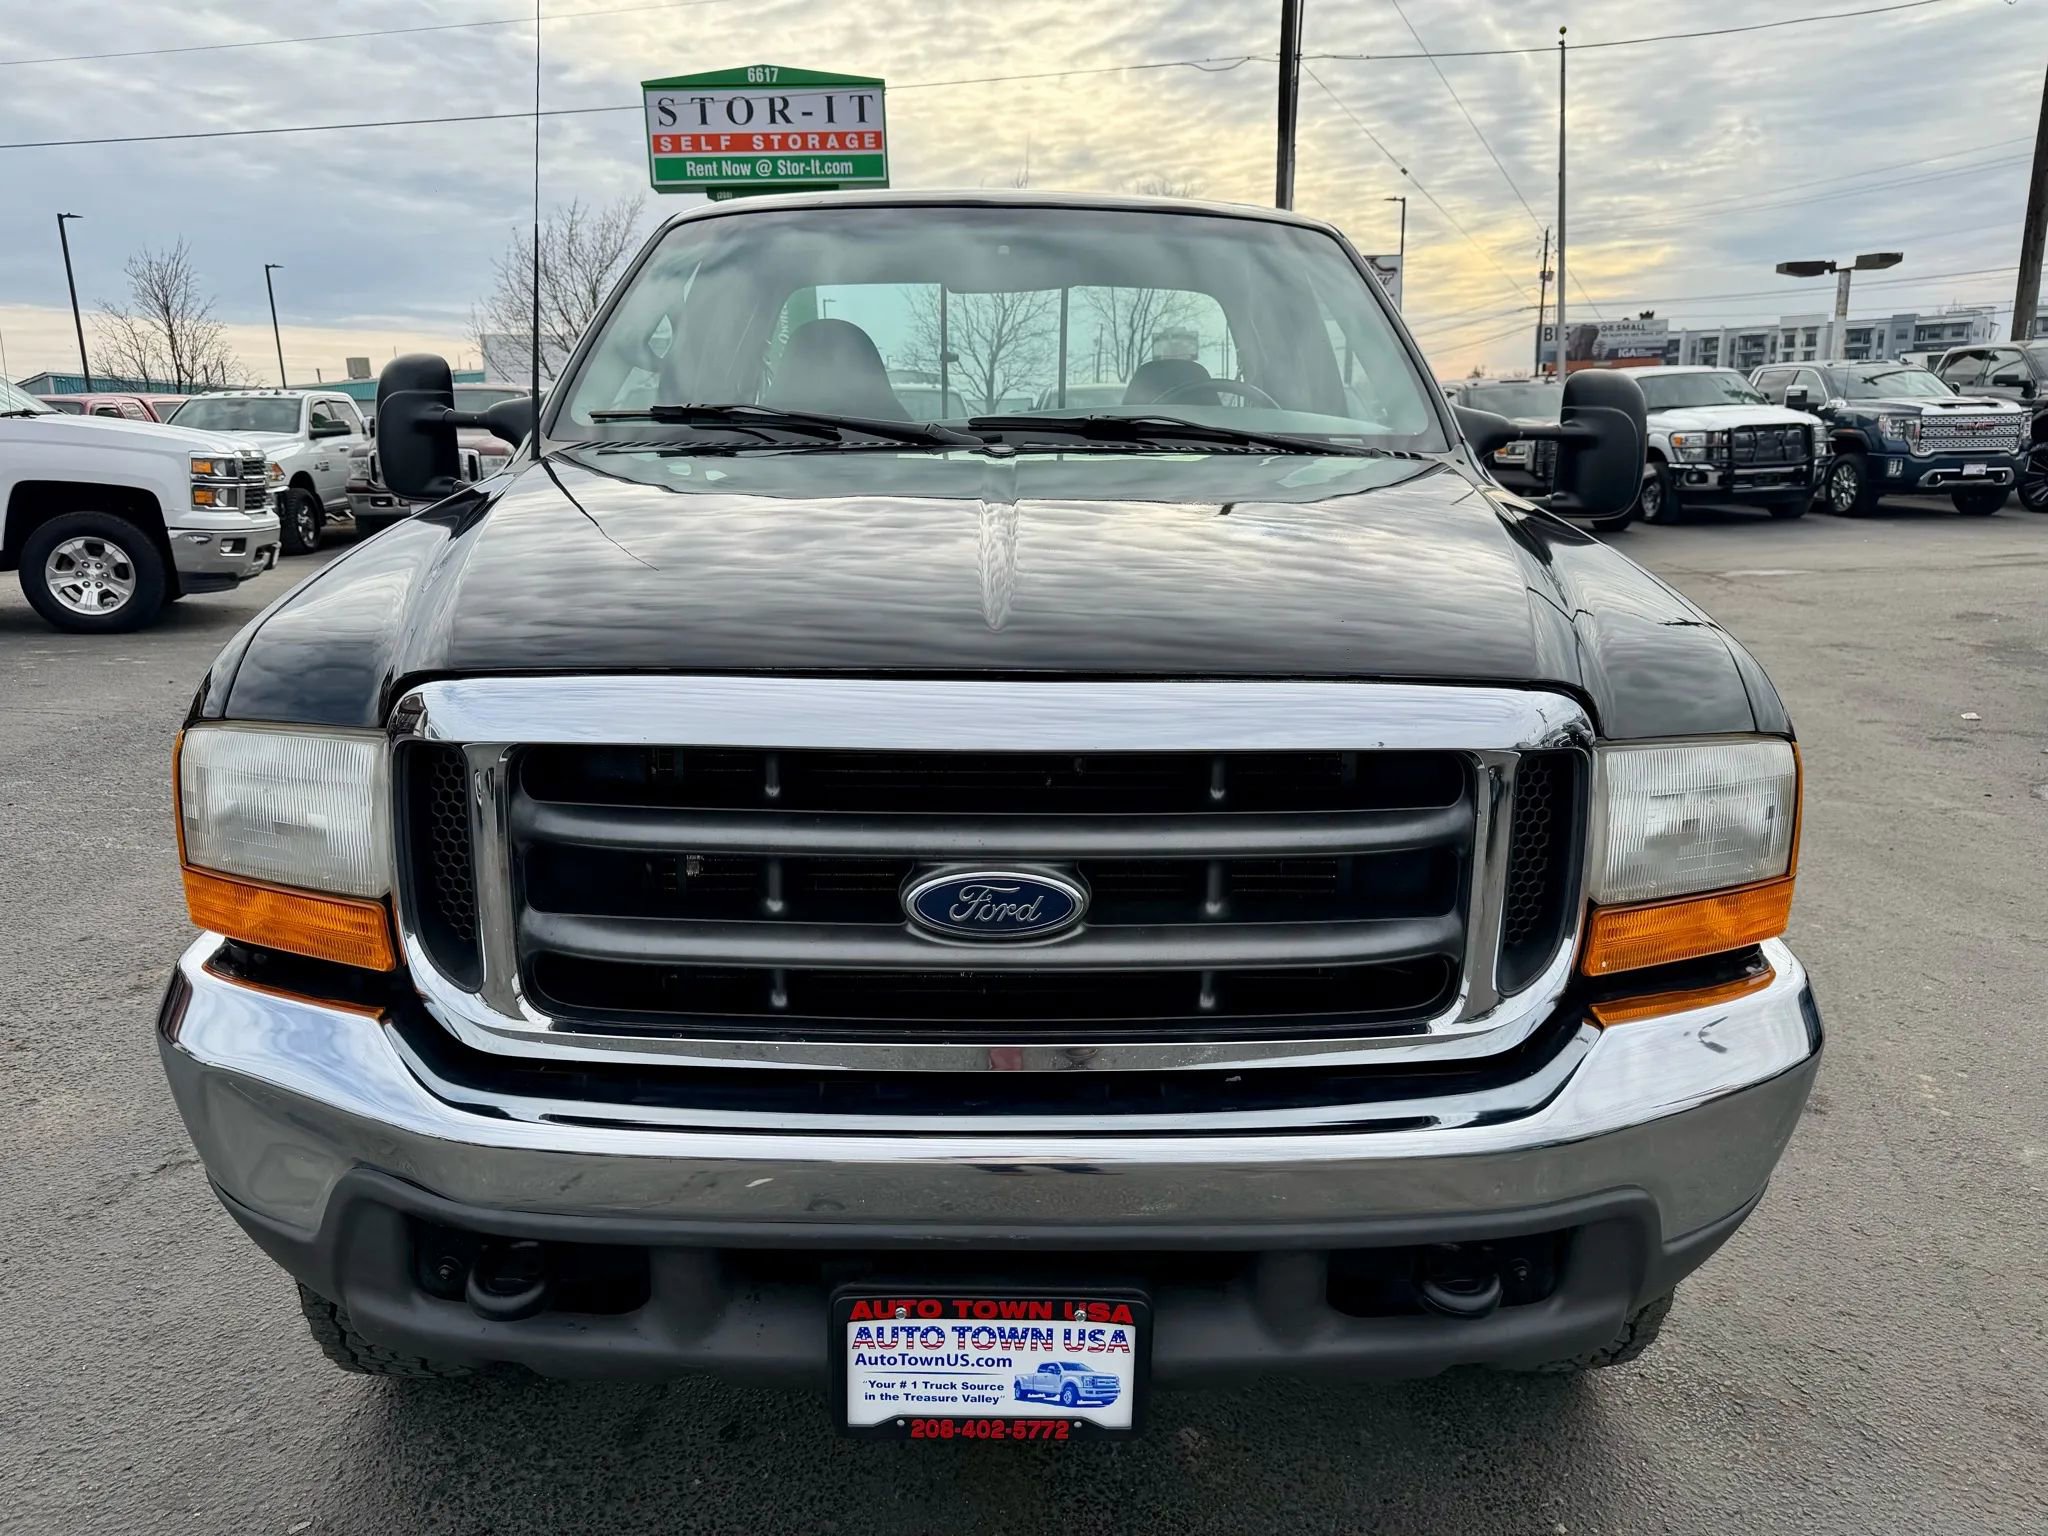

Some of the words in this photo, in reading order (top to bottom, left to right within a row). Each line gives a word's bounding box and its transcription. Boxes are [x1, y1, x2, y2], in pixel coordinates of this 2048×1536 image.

[747, 67, 779, 83] 6617
[657, 94, 874, 128] STOR-IT
[660, 135, 731, 152] SELF
[752, 133, 877, 151] STORAGE
[686, 160, 719, 177] Rent
[721, 160, 752, 177] Now
[756, 159, 773, 177] @
[777, 158, 854, 177] Stor-It.com
[1616, 322, 1646, 332] SMALL
[1618, 347, 1638, 359] IGA
[949, 884, 1045, 922] Ford
[850, 1299, 943, 1320] AUTO
[952, 1300, 1052, 1320] TOWN
[1064, 1301, 1134, 1324] USA
[852, 1325, 946, 1351] AUTO
[952, 1325, 1054, 1352] TOWN
[1064, 1327, 1131, 1354] USA
[854, 1352, 1013, 1369] AutoTownUS.com
[911, 1381, 918, 1390] 1
[922, 1381, 957, 1391] Truck
[961, 1381, 1005, 1392] Source
[864, 1391, 876, 1401] in
[880, 1391, 900, 1402] the
[903, 1392, 958, 1403] Treasure
[911, 1418, 1070, 1440] 208-402-5772
